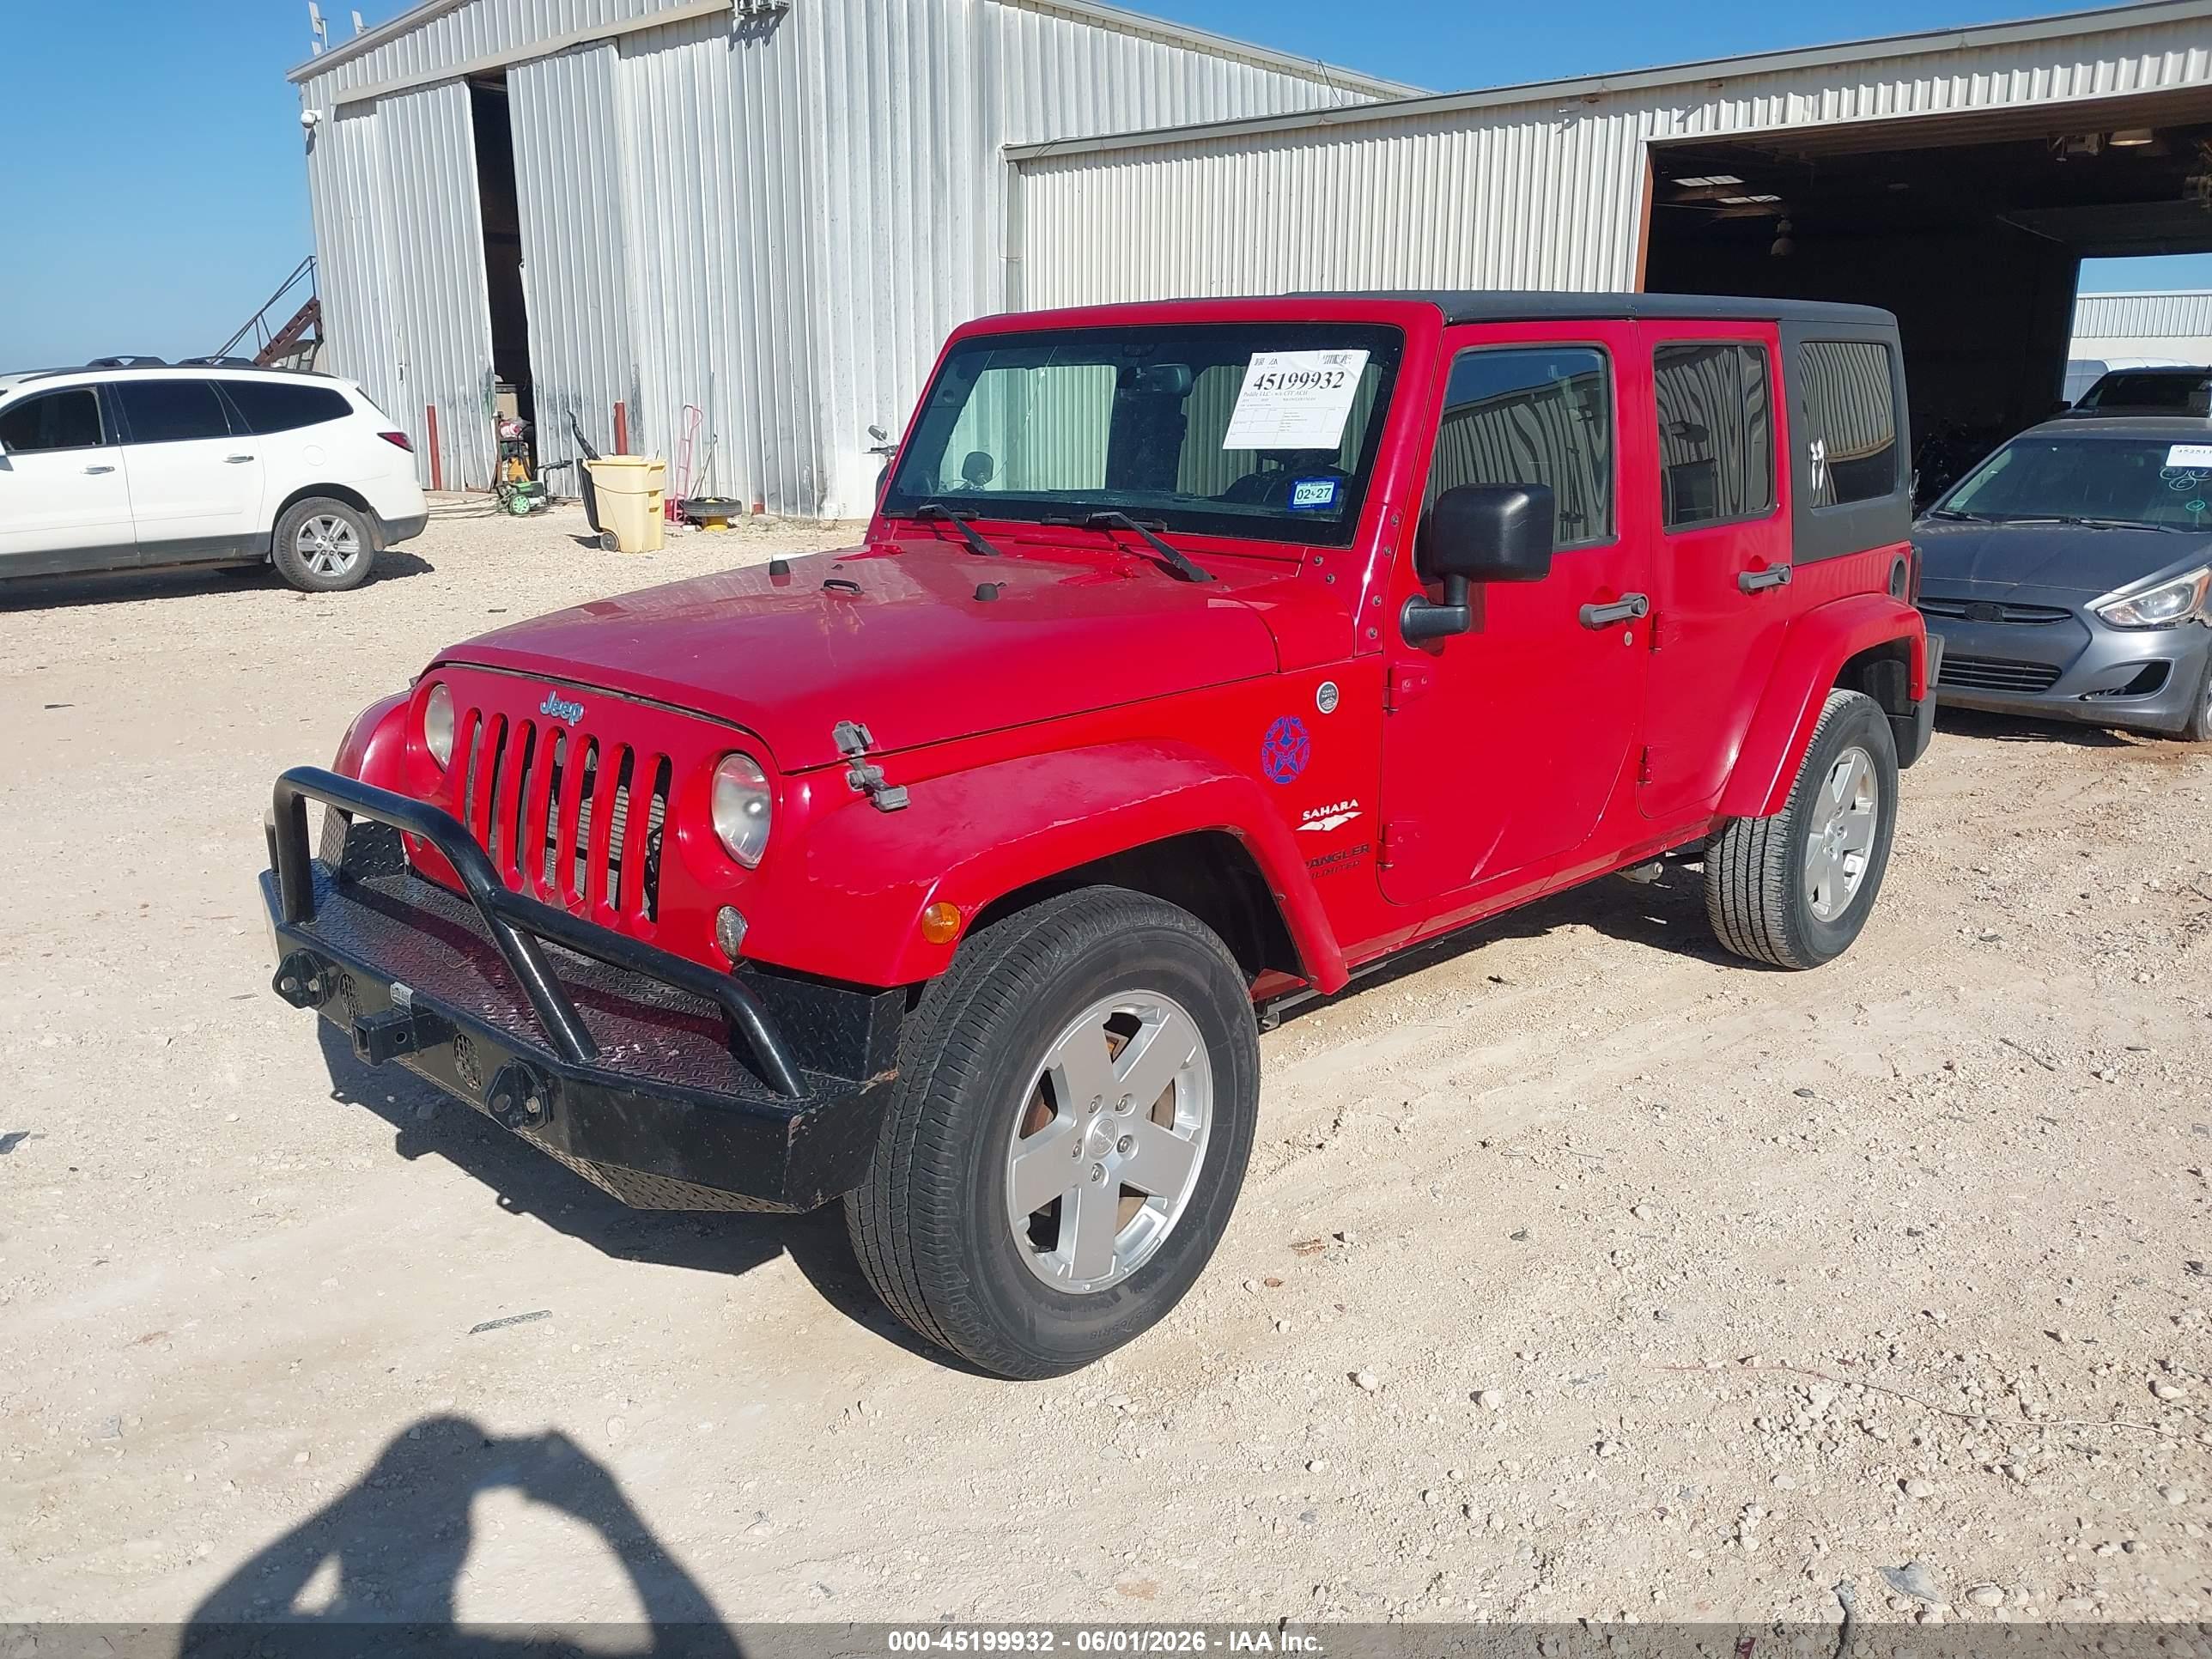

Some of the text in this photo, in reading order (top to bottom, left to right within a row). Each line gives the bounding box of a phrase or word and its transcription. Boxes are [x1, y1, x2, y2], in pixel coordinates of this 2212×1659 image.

[1253, 371, 1345, 391] 45199932
[539, 690, 585, 727] Jeep
[1302, 799, 1359, 821] SAHARA
